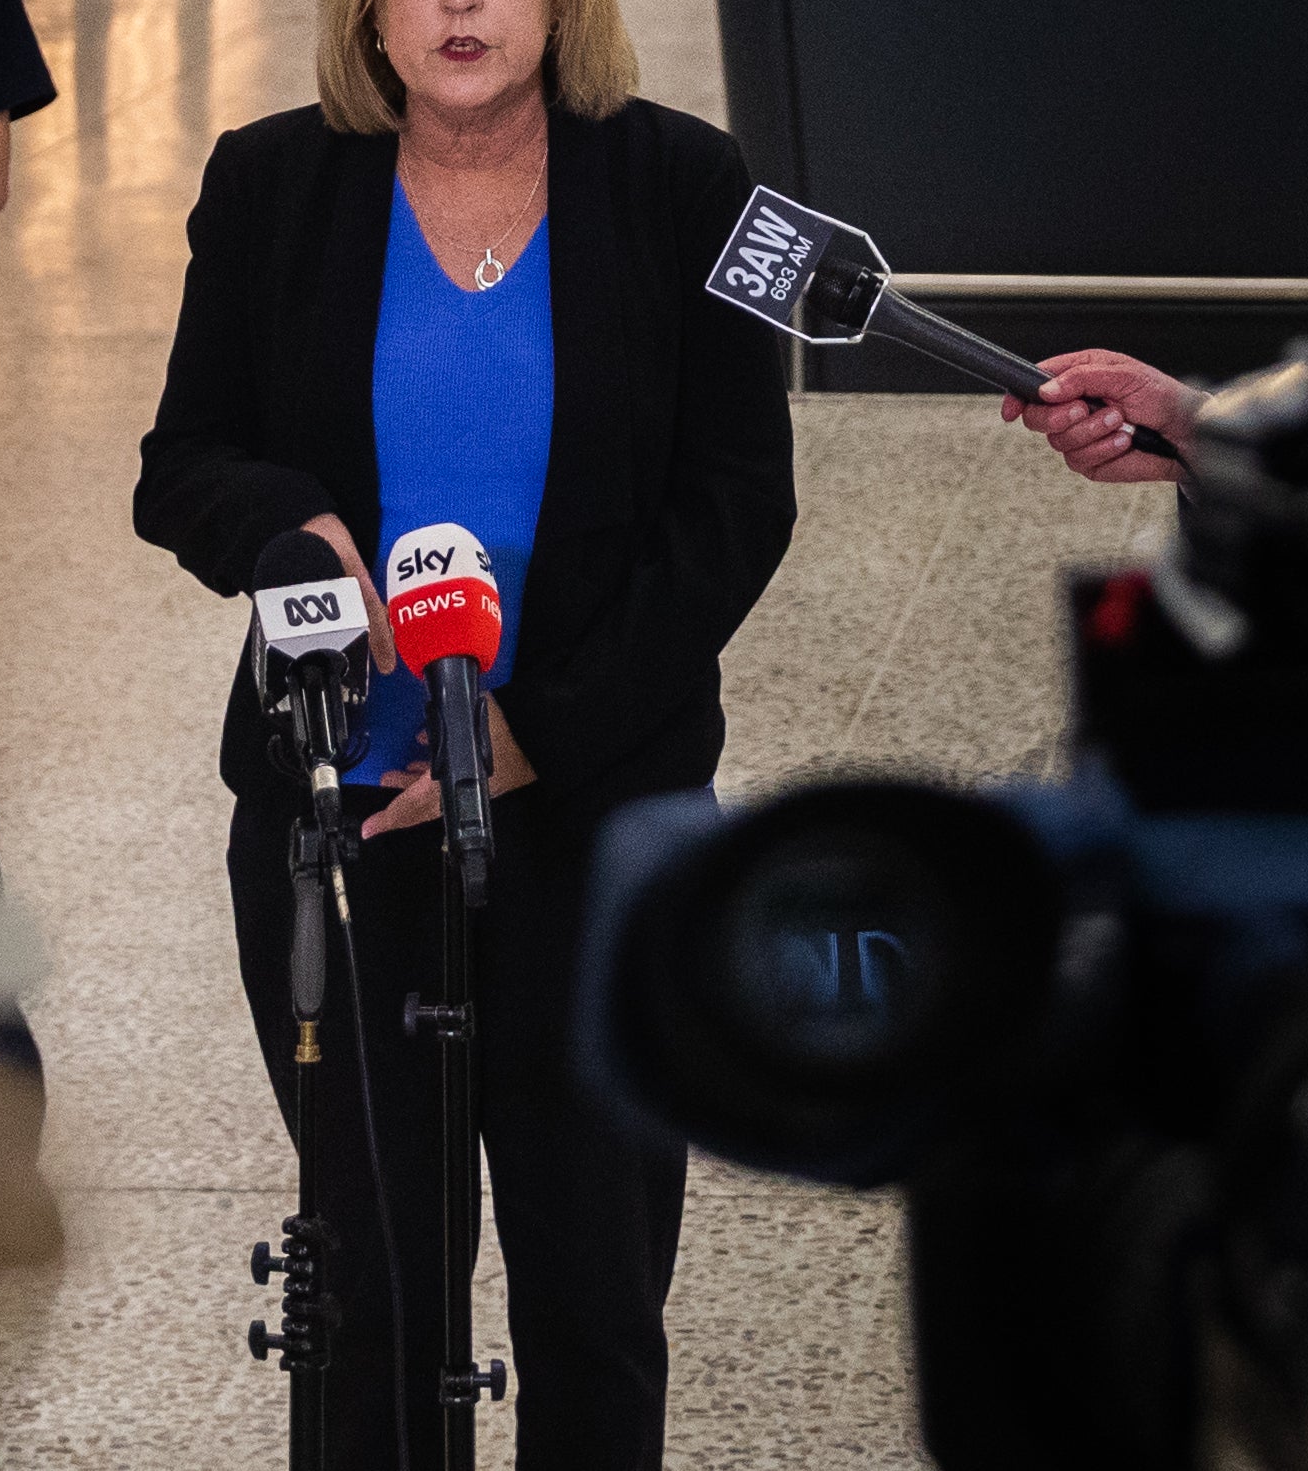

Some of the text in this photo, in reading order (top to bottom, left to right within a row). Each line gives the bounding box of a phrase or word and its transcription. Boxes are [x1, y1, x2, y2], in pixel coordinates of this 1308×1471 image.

[726, 205, 798, 298] 3AW
[770, 235, 814, 301] 693 AM
[397, 546, 456, 581] sky
[398, 590, 466, 625] news
